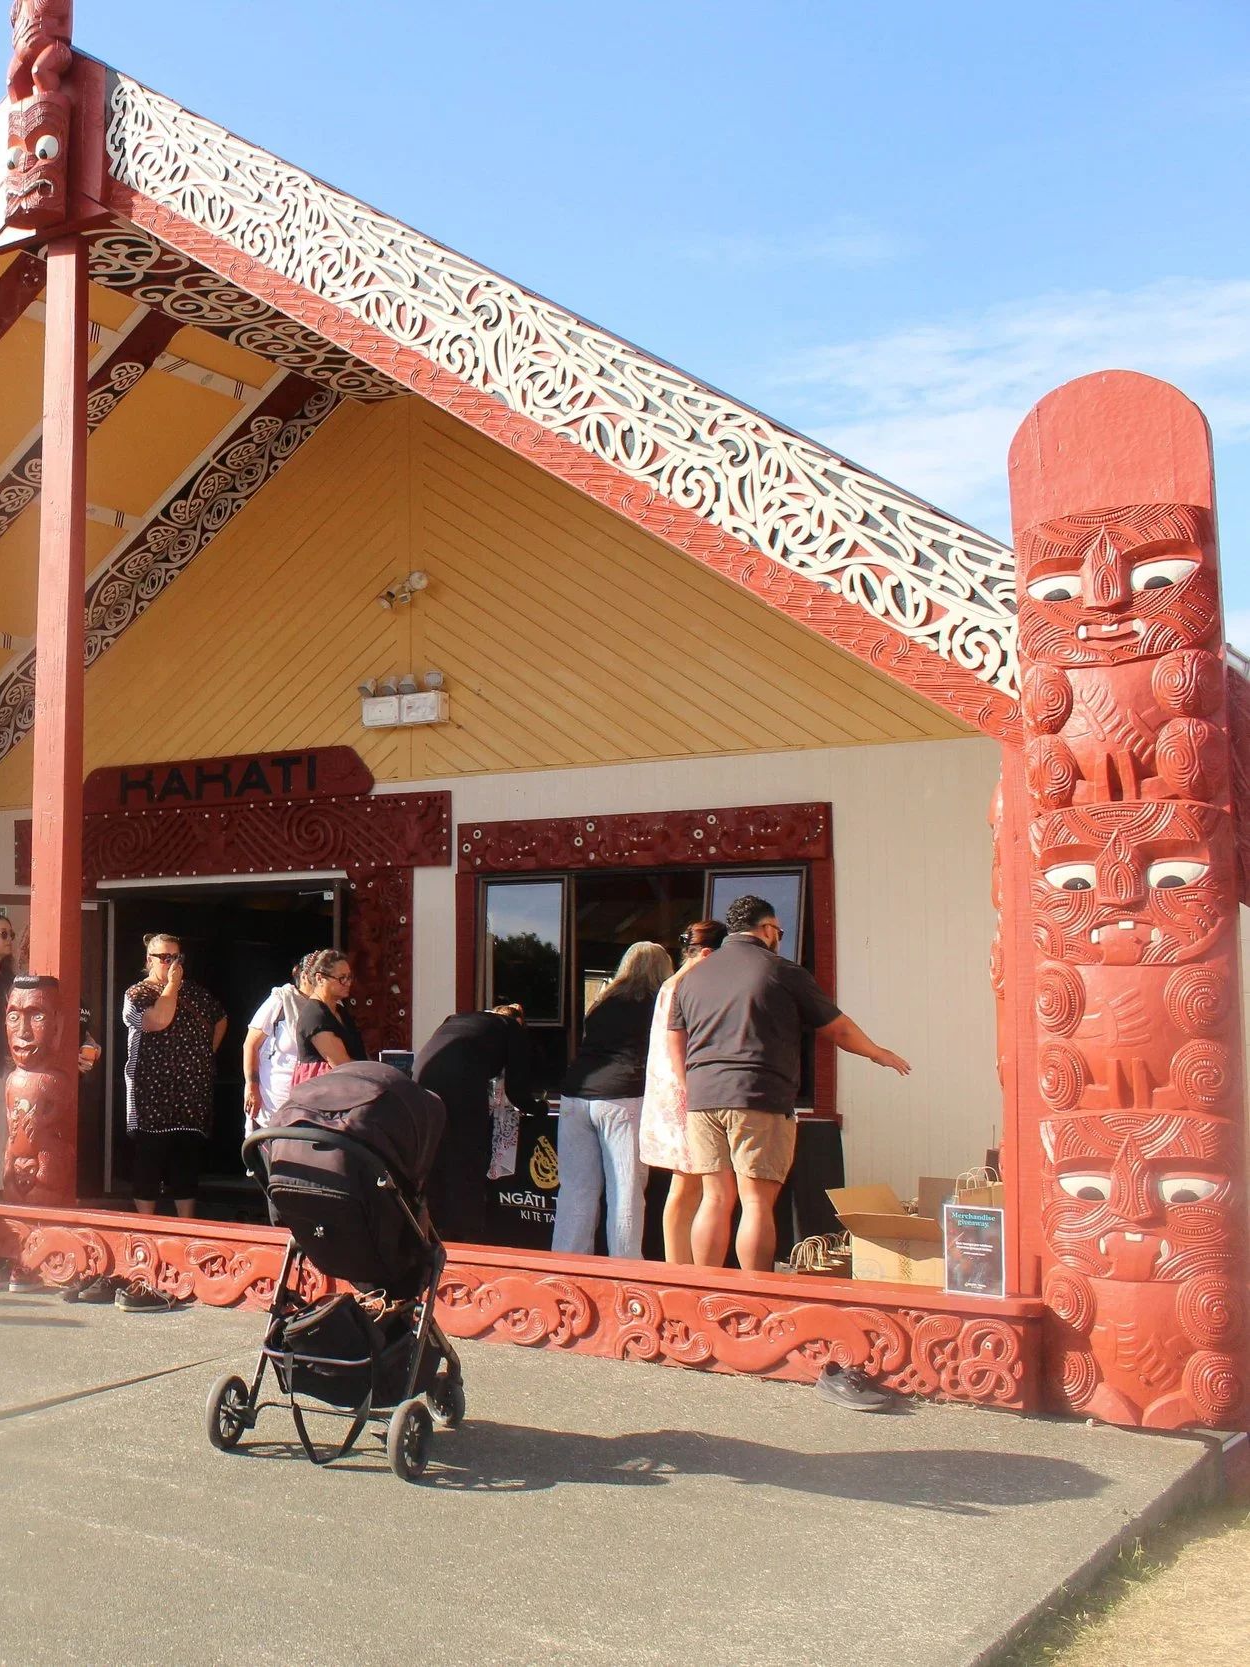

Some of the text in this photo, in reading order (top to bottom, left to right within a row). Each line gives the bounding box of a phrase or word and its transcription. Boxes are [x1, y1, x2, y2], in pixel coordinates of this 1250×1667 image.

[499, 1190, 546, 1208] NGĀTI
[520, 1210, 530, 1220] KI
[532, 1211, 541, 1222] TE
[951, 1211, 996, 1222] Merchandise
